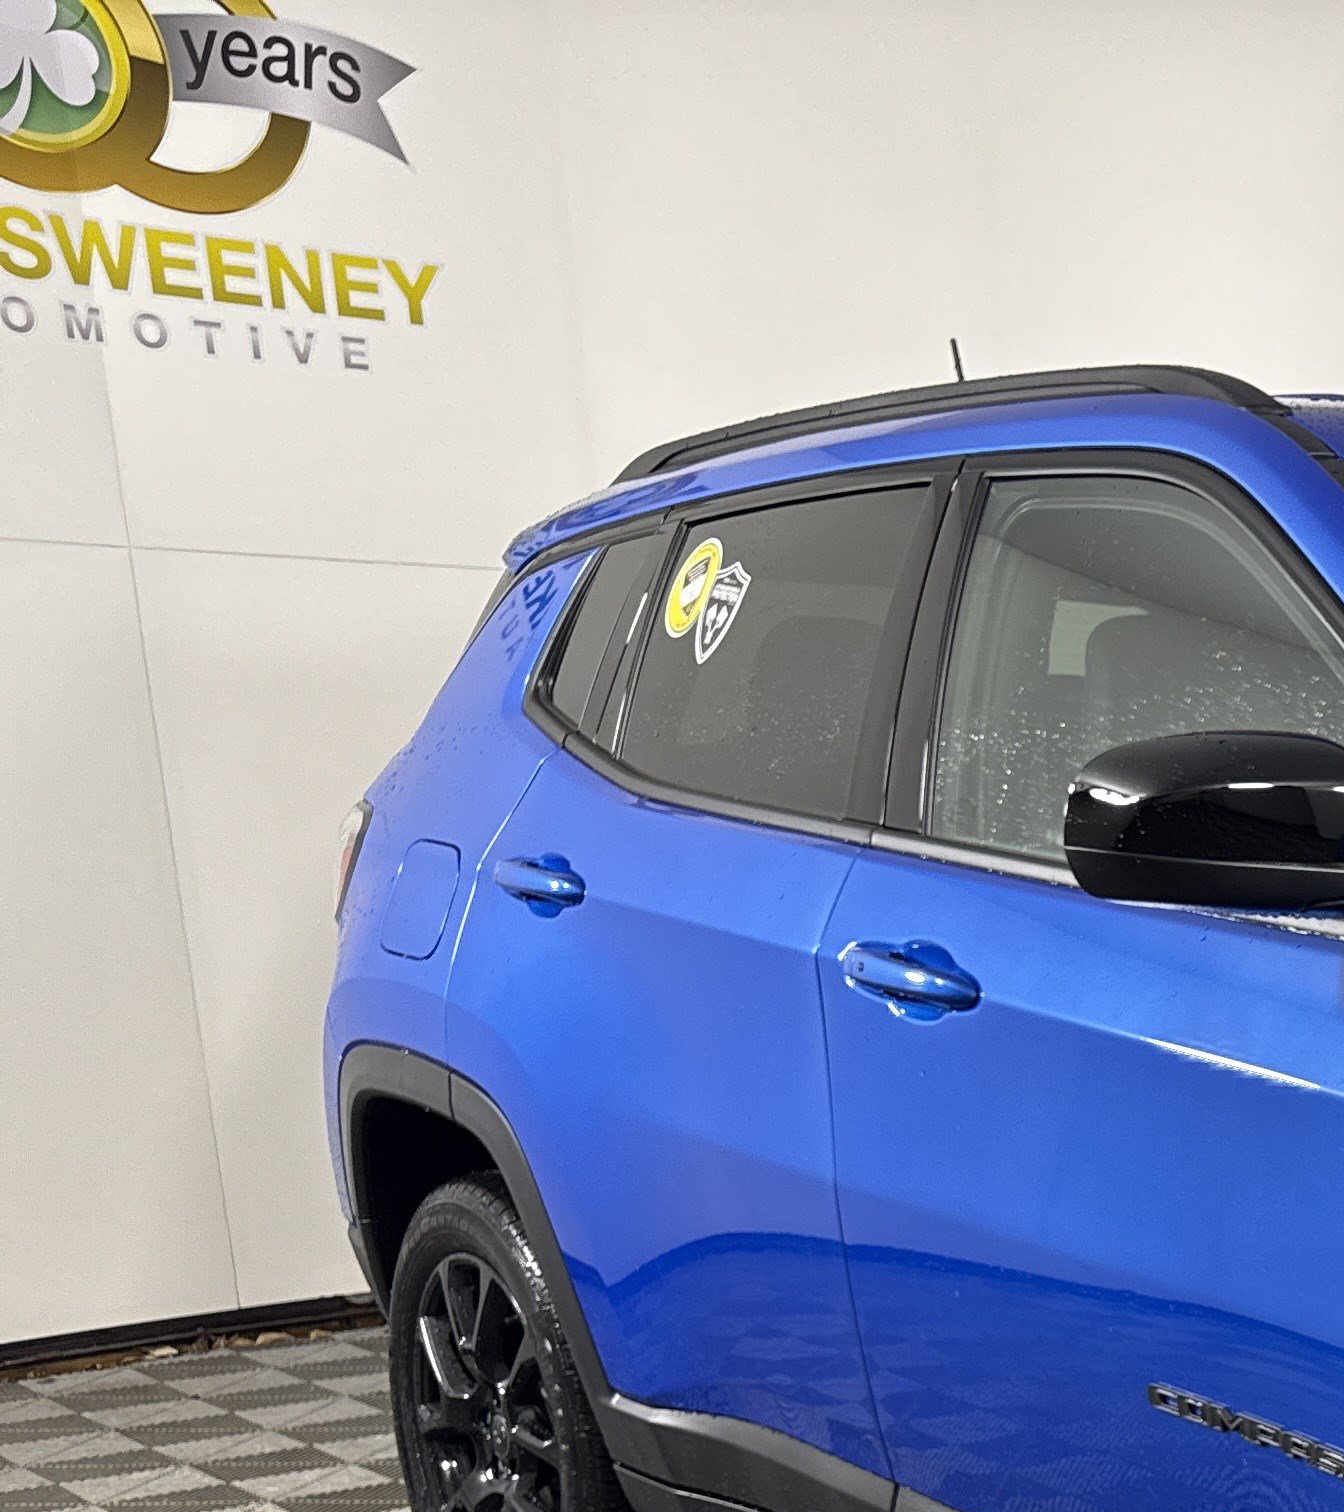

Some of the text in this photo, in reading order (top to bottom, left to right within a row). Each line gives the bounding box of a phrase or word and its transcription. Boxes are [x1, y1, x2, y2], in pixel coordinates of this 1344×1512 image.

[180, 26, 362, 104] years
[0, 206, 439, 326] SWEENEY
[0, 297, 370, 371] OMOTIVE
